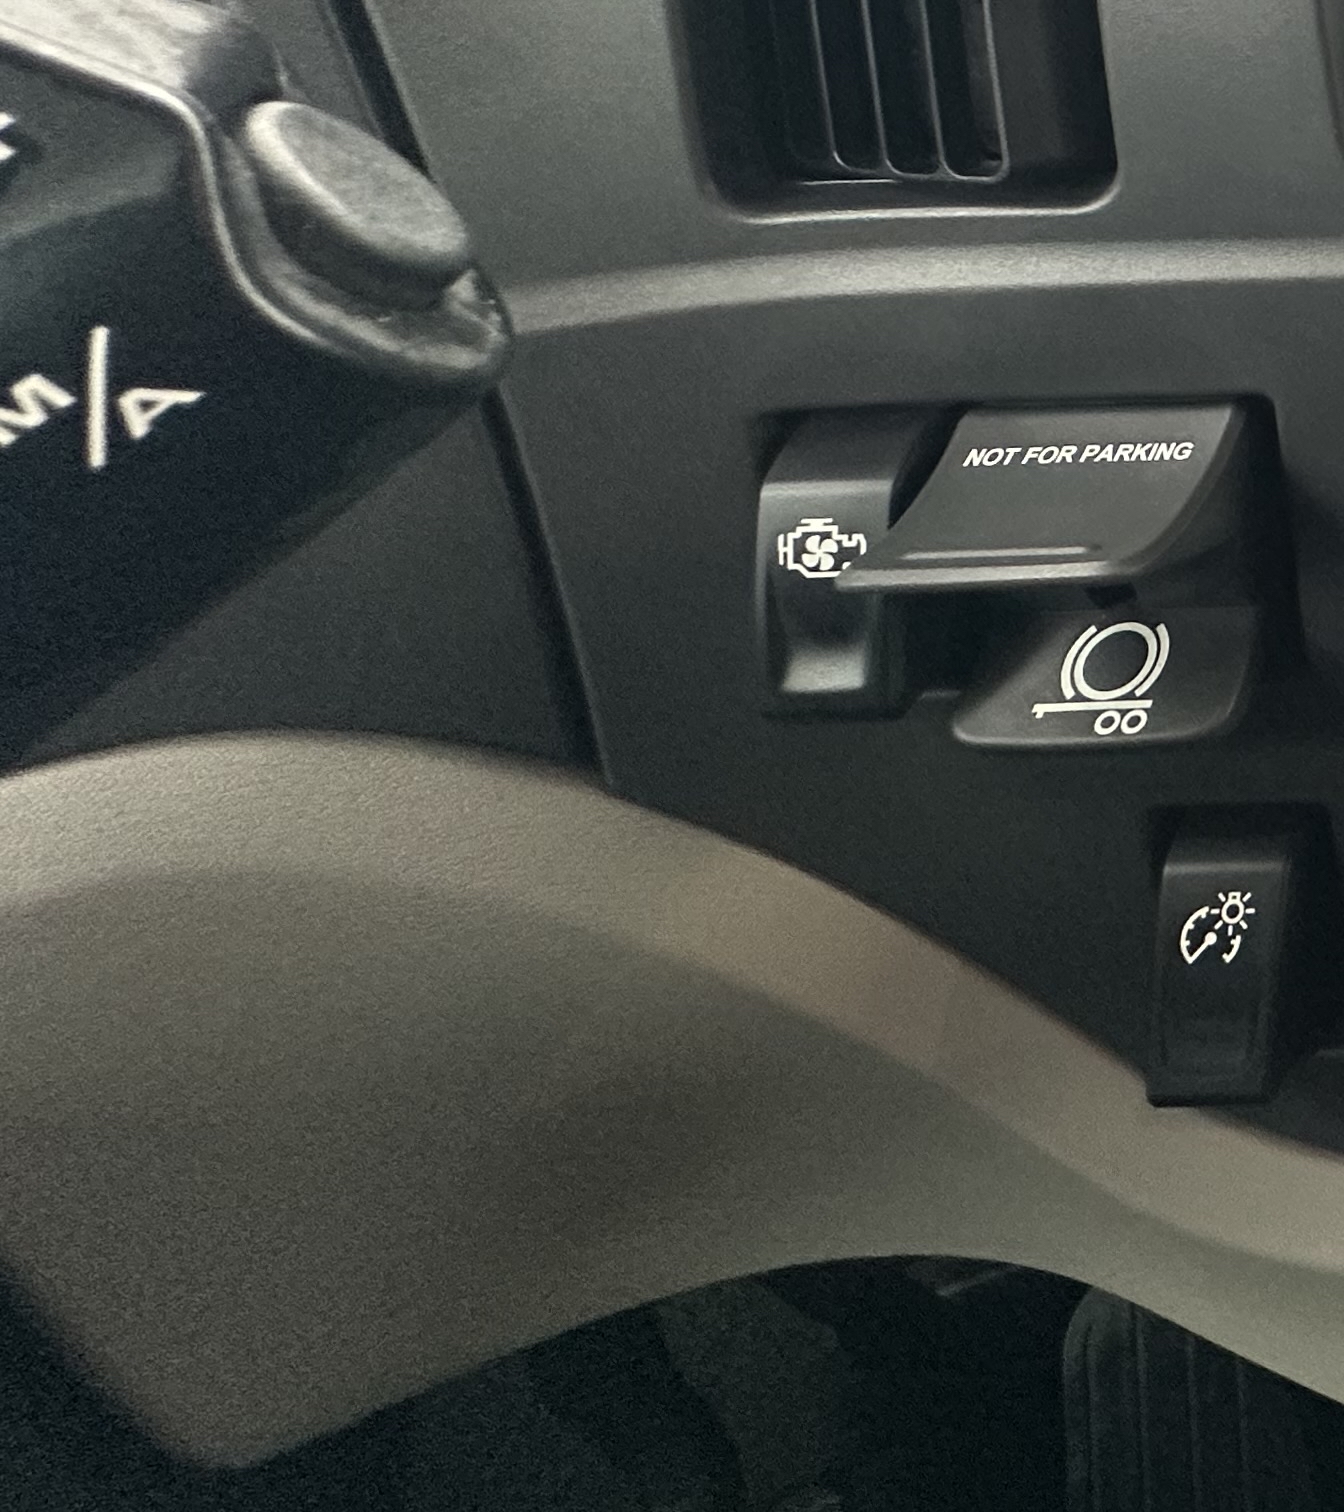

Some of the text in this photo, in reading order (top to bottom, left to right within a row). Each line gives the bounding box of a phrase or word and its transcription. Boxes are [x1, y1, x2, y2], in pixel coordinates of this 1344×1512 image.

[962, 441, 1196, 467] NOT FOR PARKING
